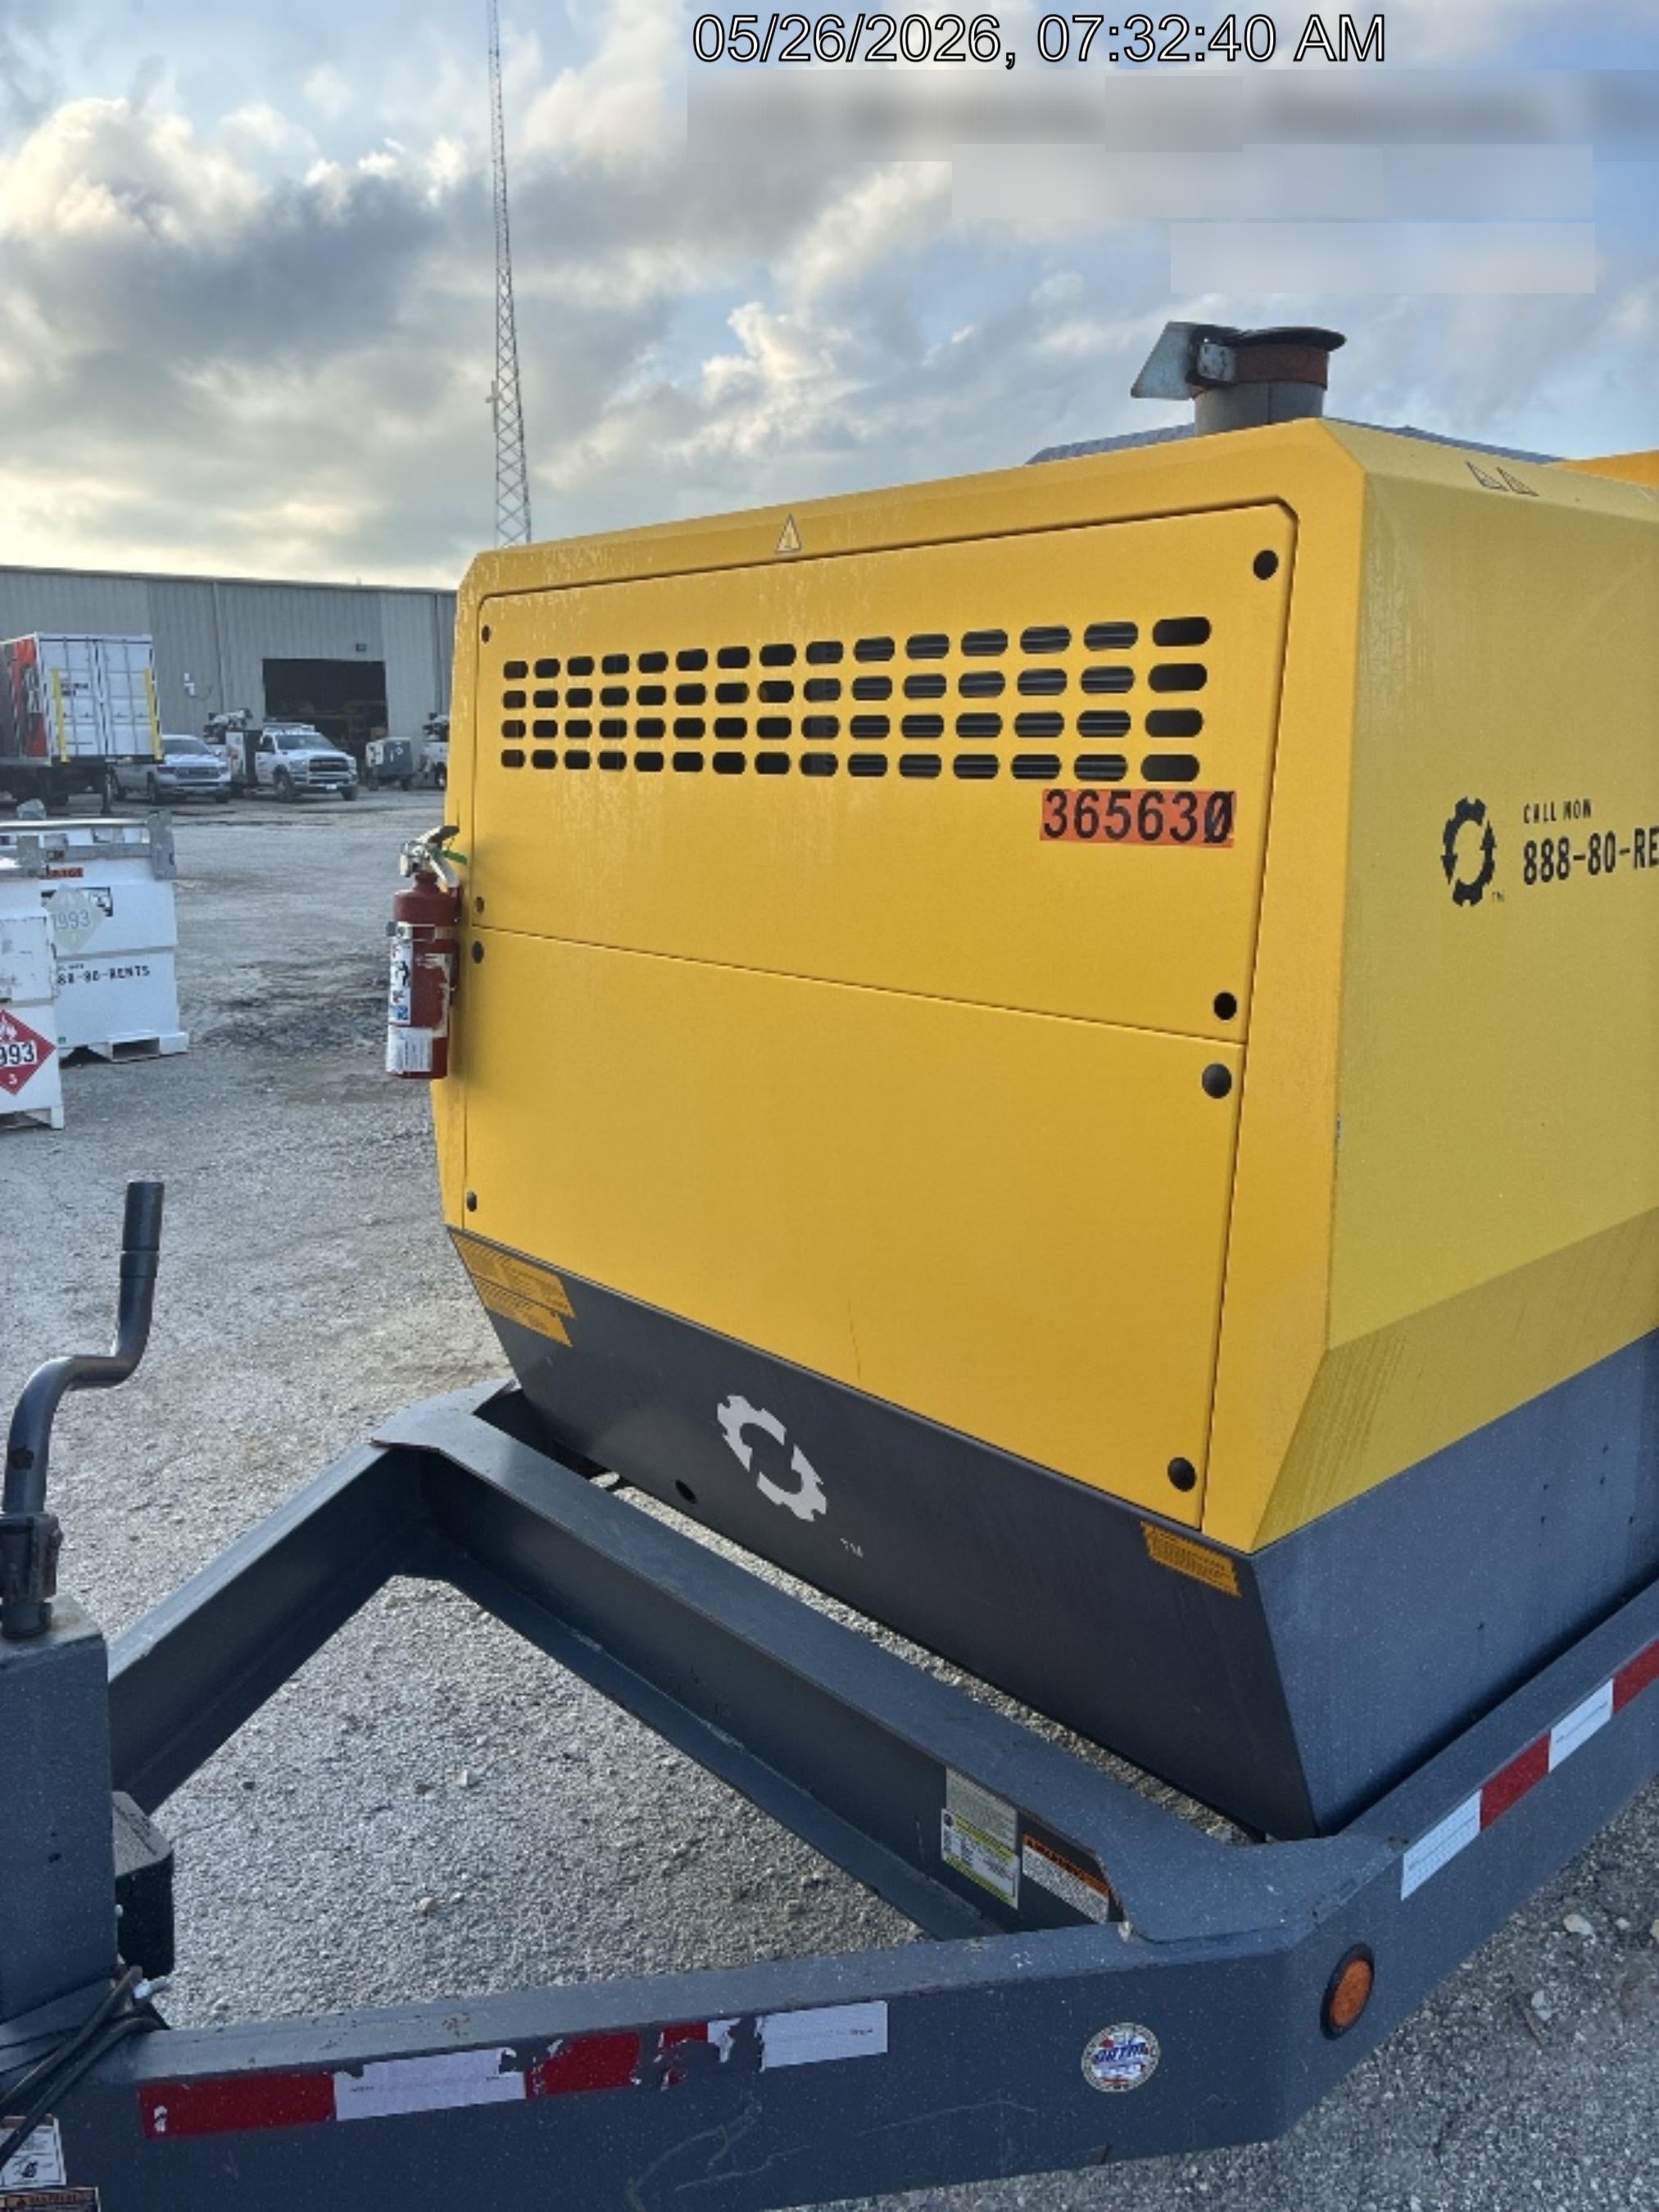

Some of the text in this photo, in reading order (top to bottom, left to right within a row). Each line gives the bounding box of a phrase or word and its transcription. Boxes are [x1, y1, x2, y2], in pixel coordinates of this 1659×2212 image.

[1044, 788, 1235, 844] 365630
[1523, 799, 1592, 823] CALL NOW
